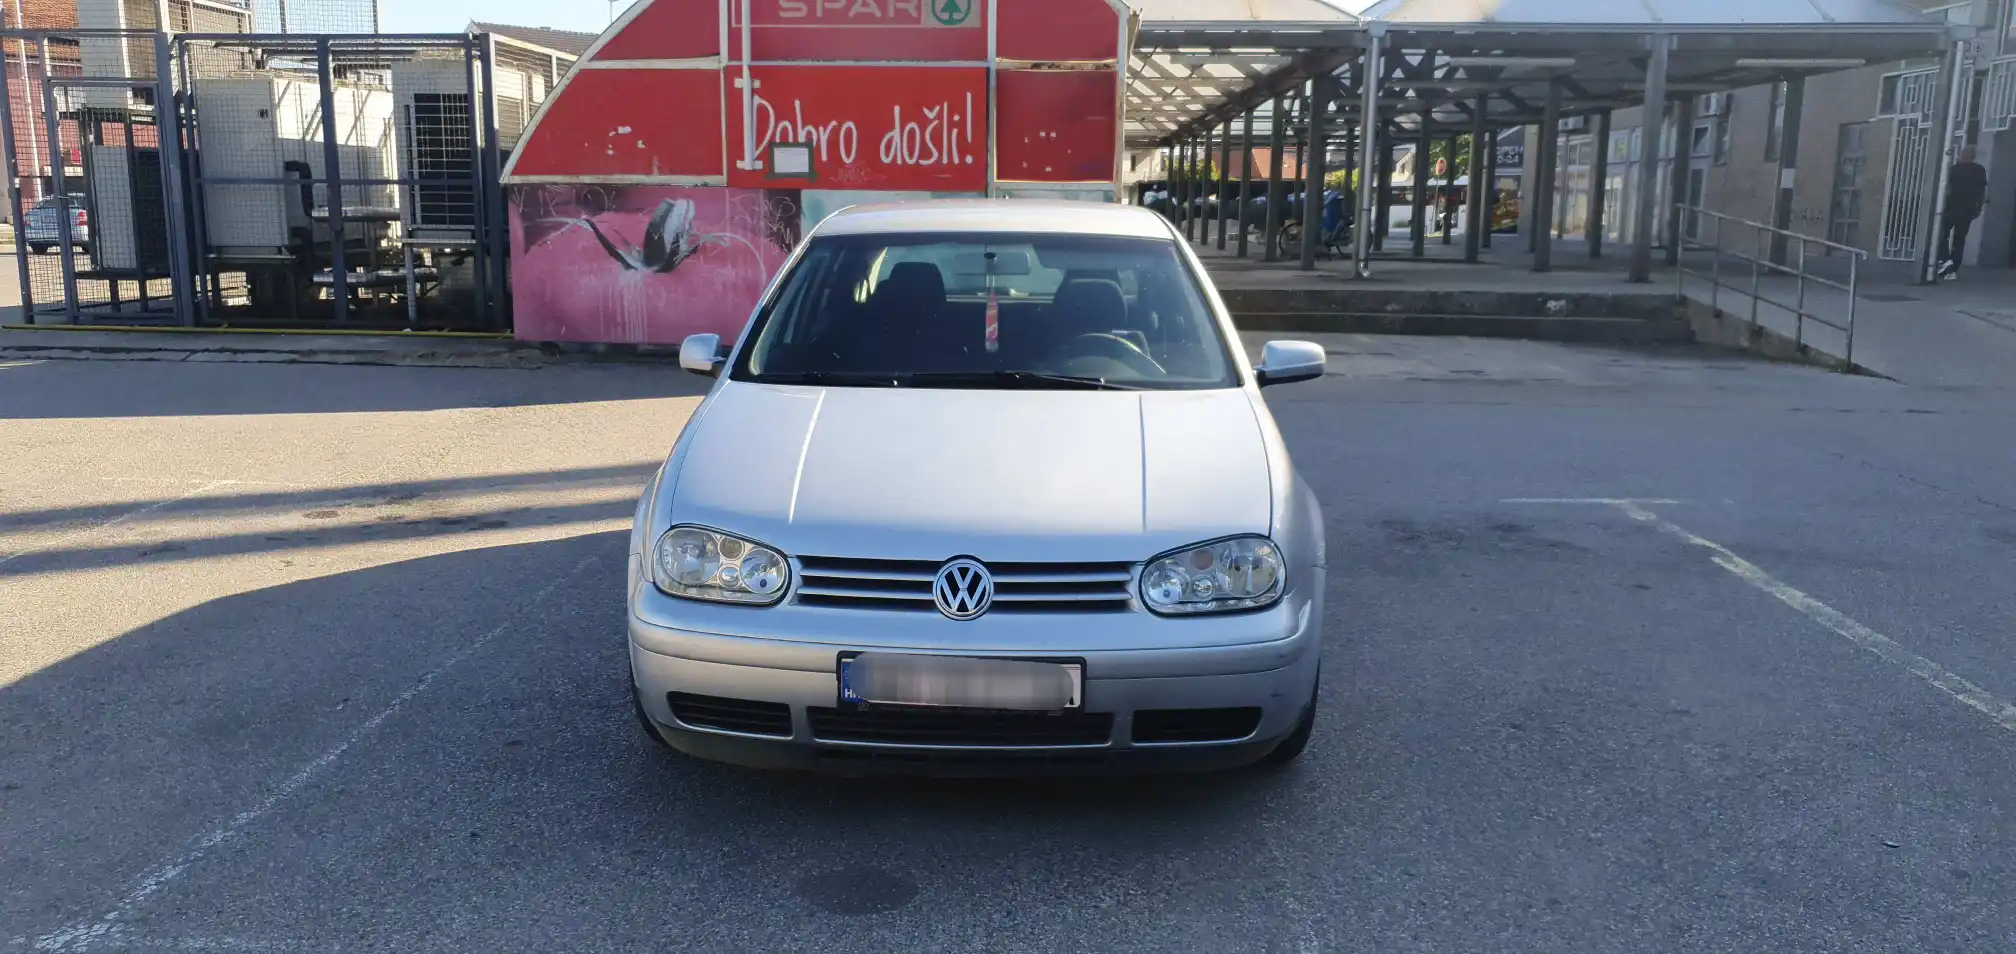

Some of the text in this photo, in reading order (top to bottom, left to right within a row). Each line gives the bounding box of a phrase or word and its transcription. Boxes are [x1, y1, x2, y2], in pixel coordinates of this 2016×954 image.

[778, 0, 919, 18] SPAR
[751, 91, 973, 165] Dobro došli!
[937, 564, 990, 615] VW
